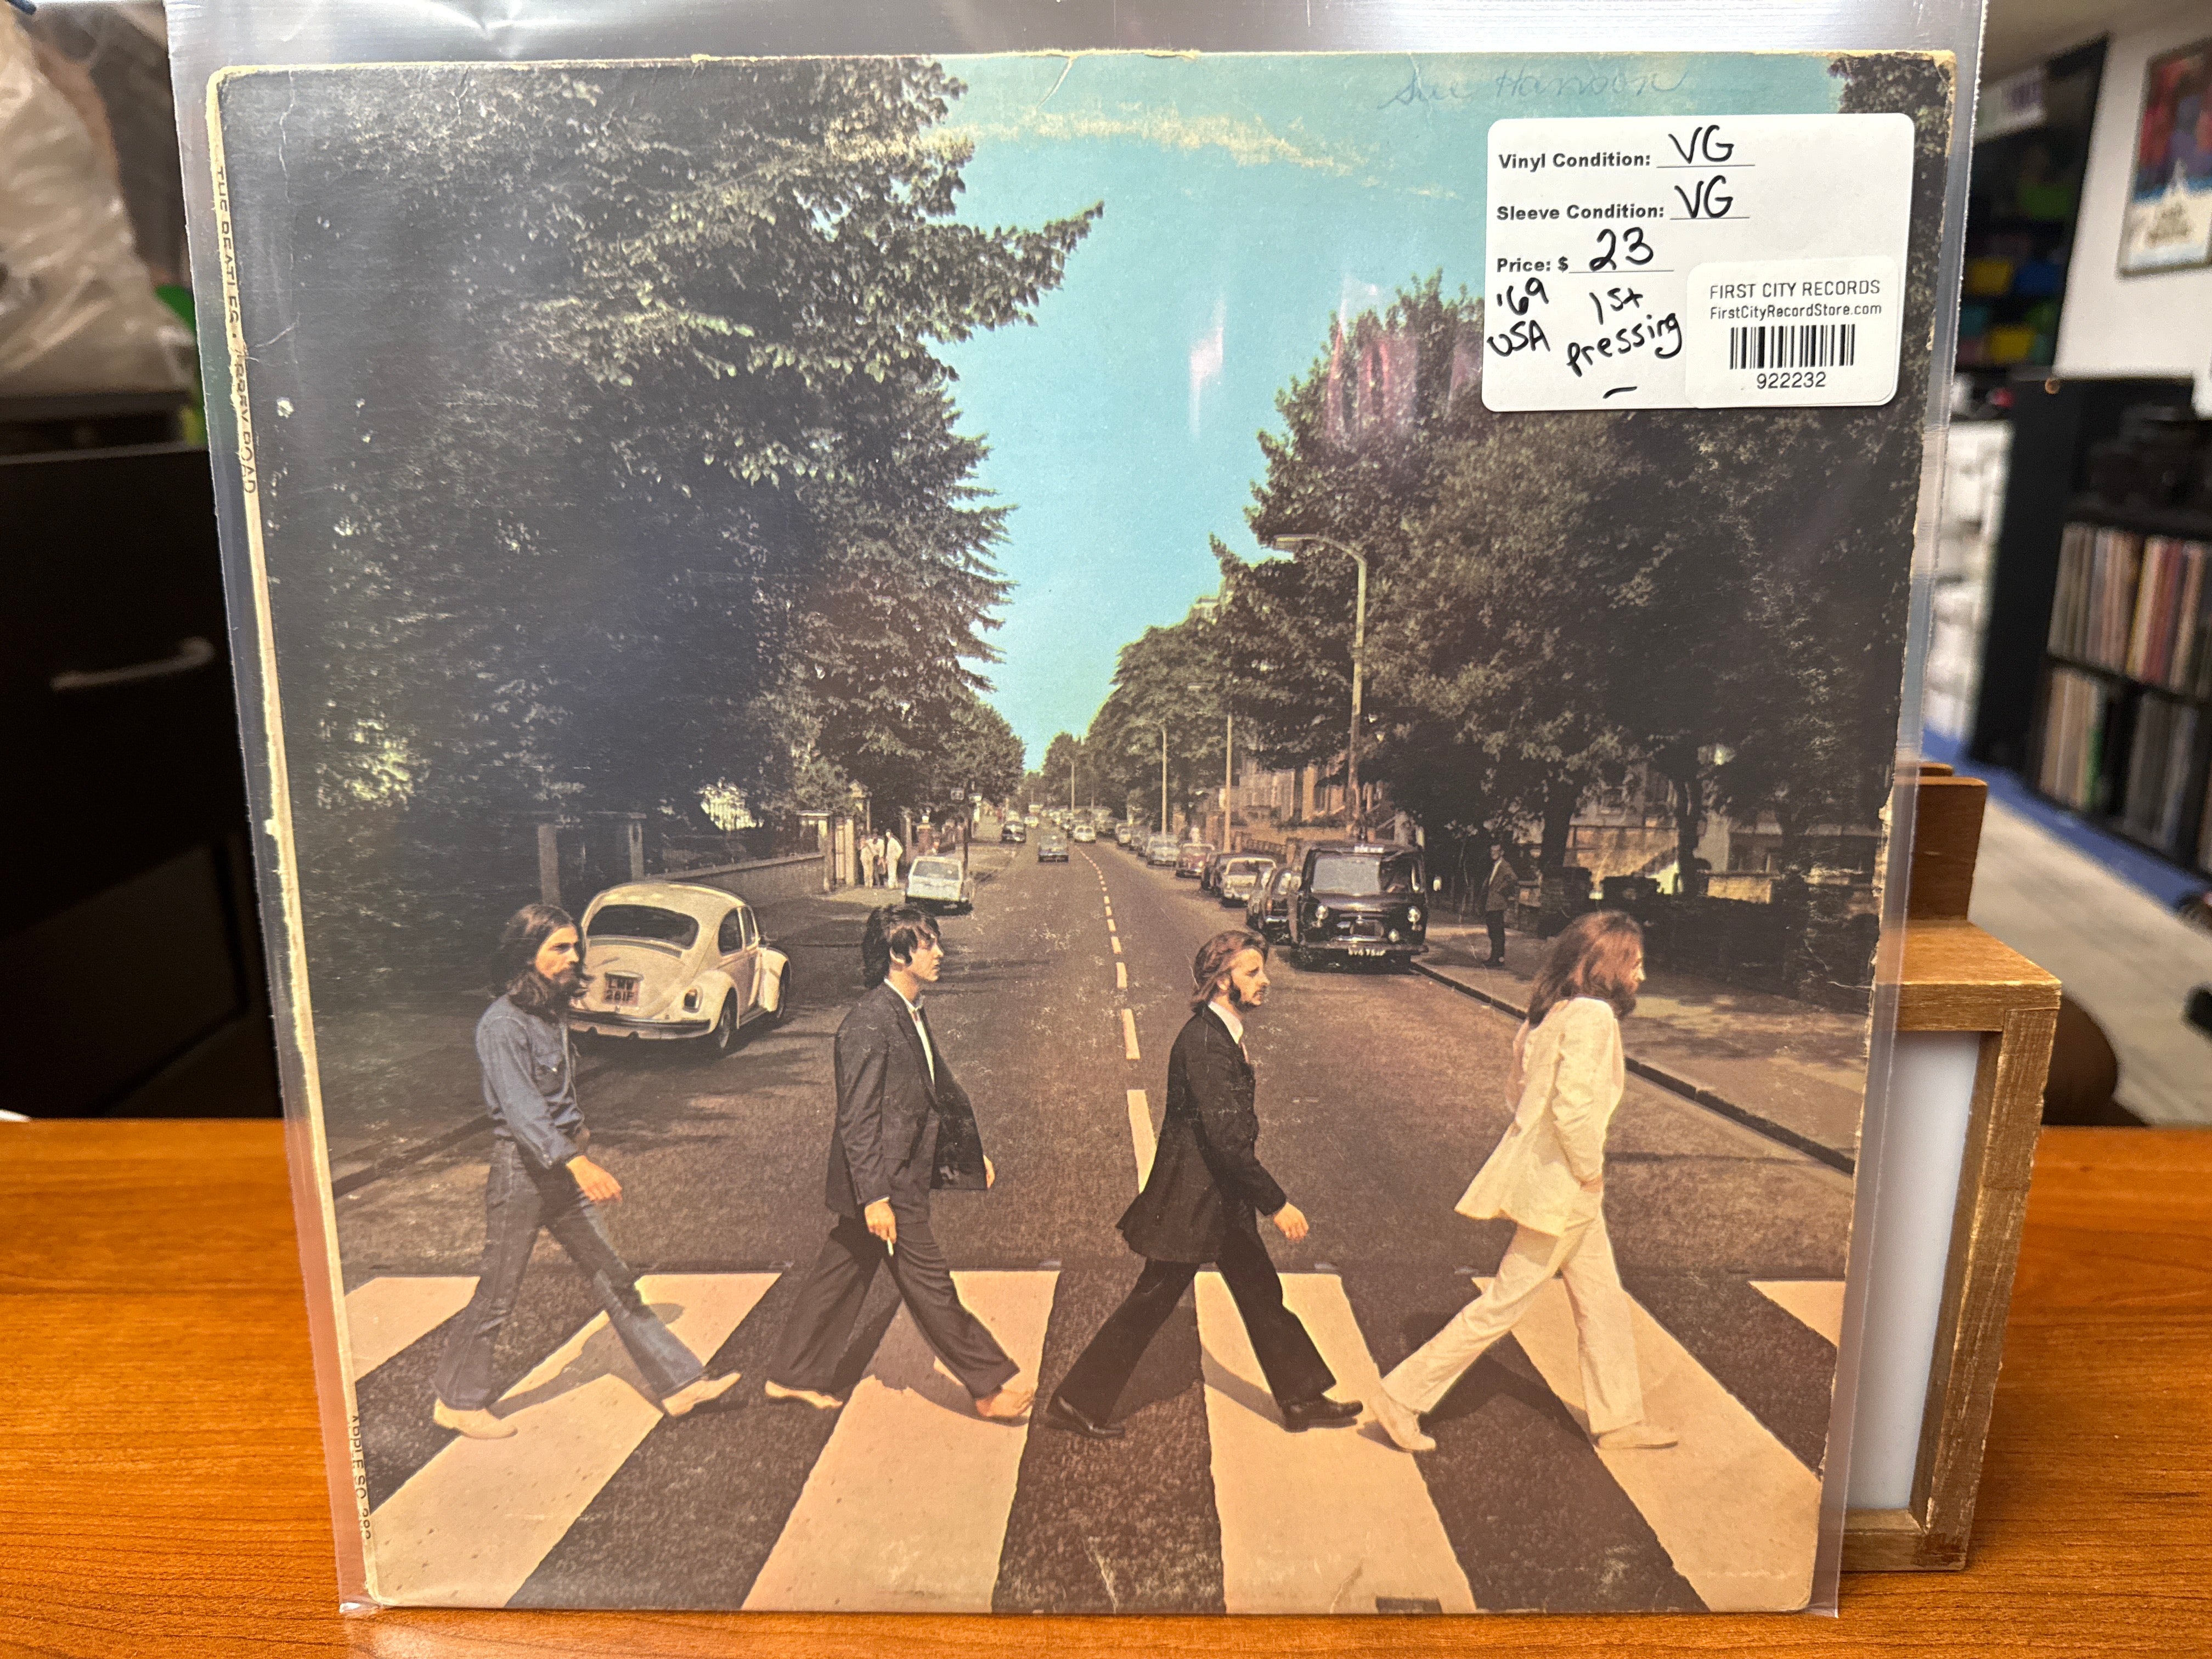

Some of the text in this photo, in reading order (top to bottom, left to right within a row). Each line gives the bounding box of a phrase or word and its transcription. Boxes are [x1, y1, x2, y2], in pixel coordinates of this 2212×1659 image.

[1498, 125, 1734, 172] Vinyl Condition: VG
[1497, 175, 1734, 221] Sleeve Condition: VG
[1497, 227, 1654, 273] Price: $ 23
[1497, 277, 1644, 325] '69 1st
[1710, 279, 1880, 299] FIRST CITY RECORDS
[1710, 302, 1882, 320] FirstCityRecordStore.com
[1487, 320, 1551, 357] USA
[1757, 371, 1826, 390] 922232
